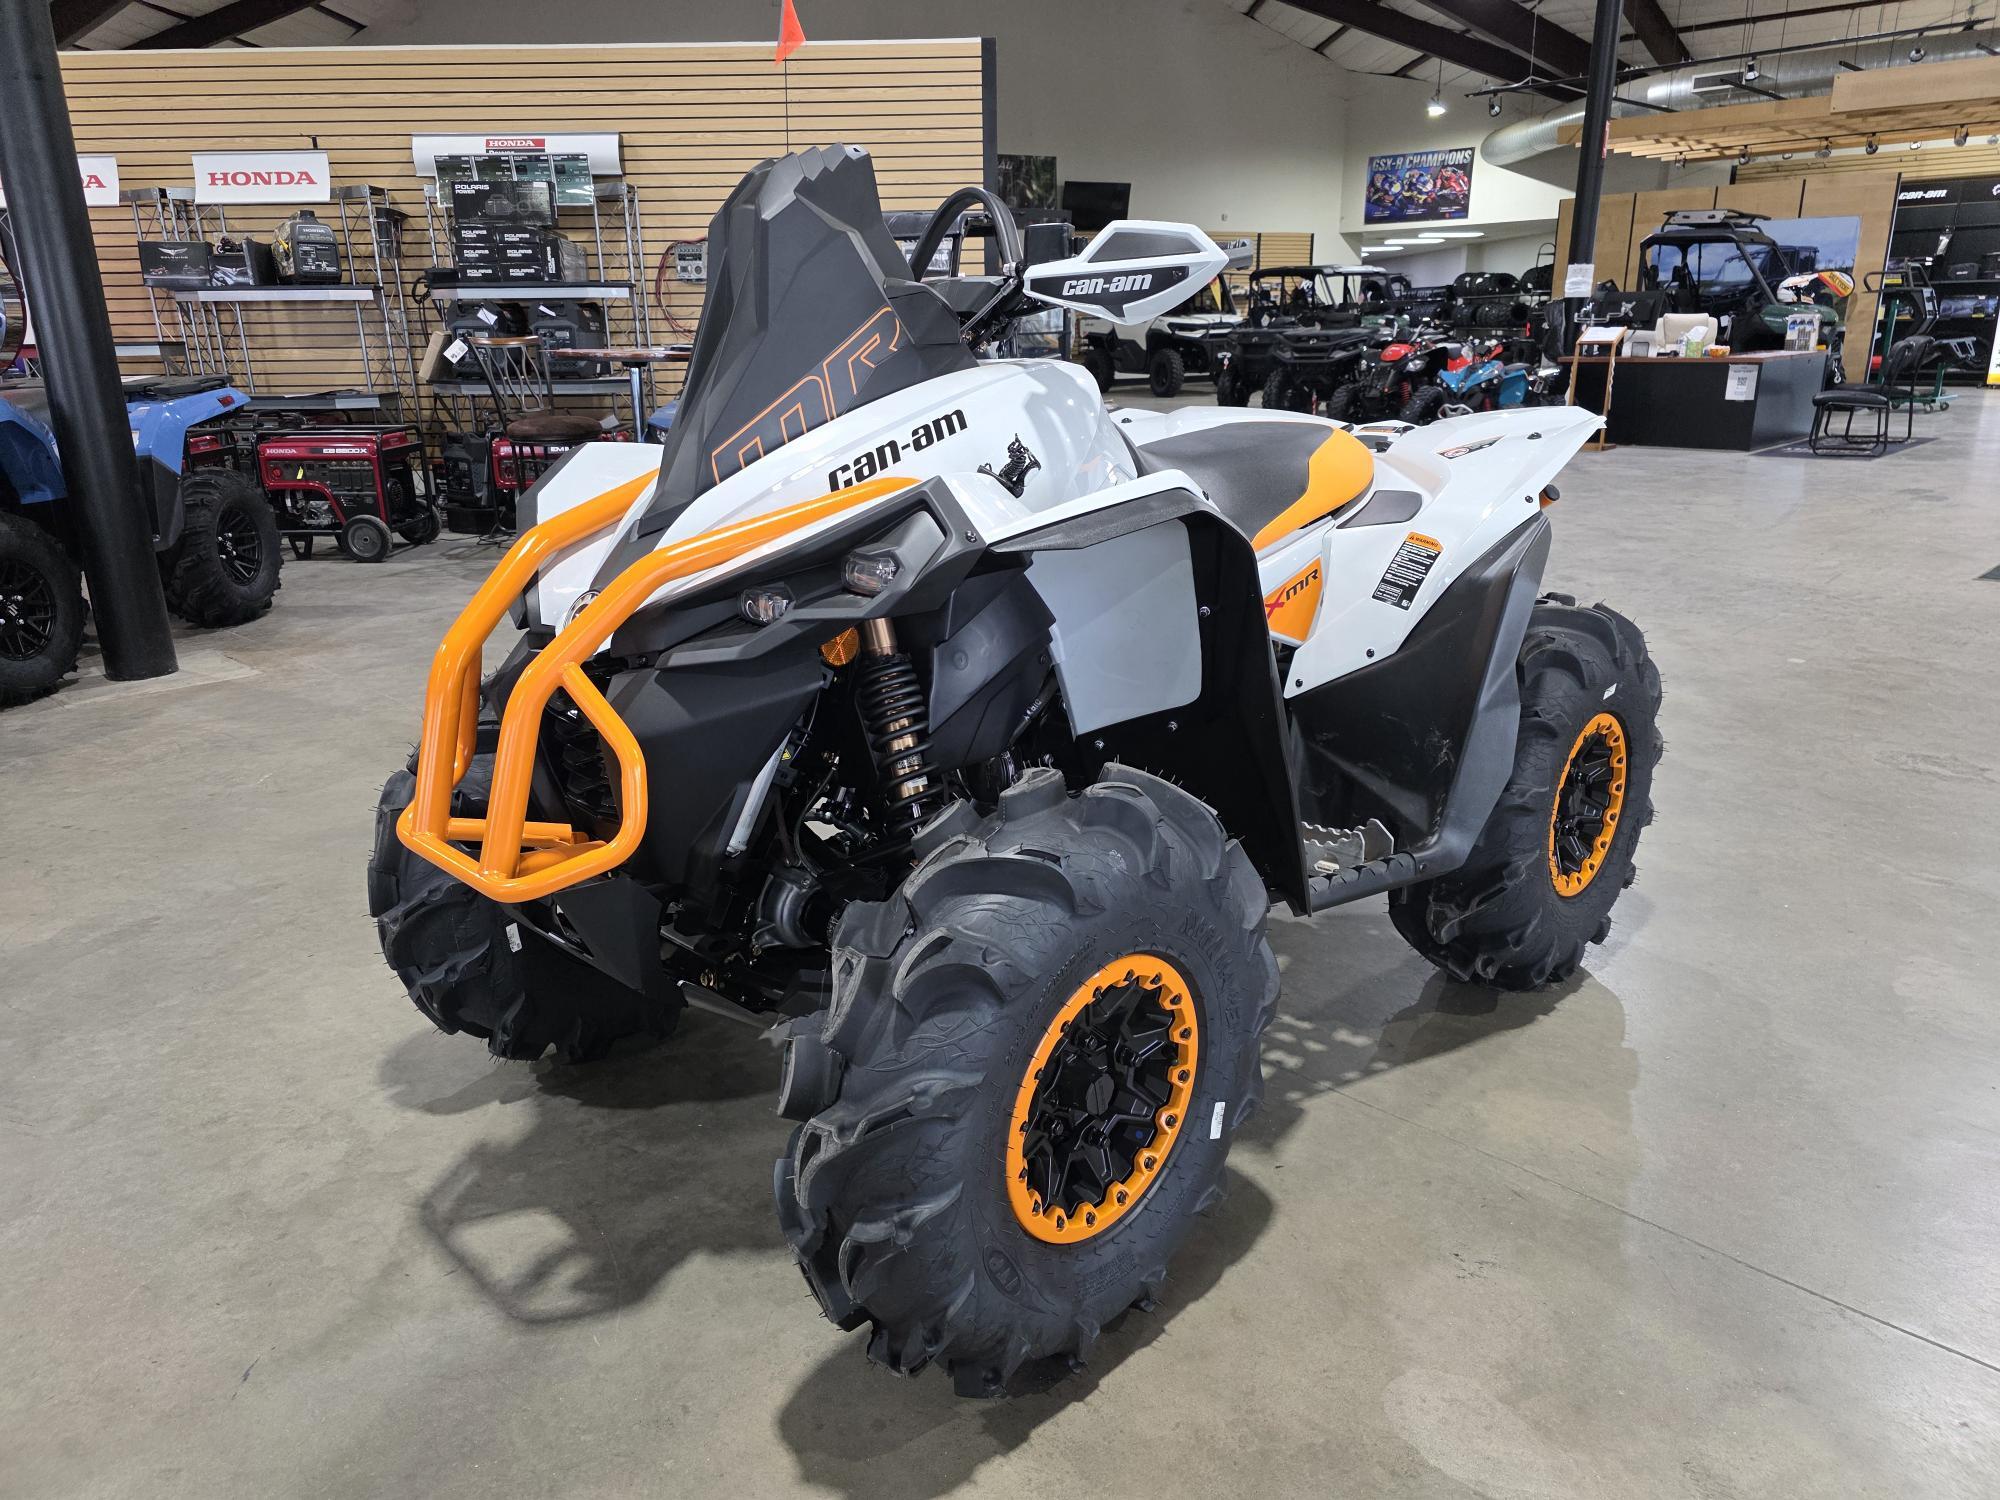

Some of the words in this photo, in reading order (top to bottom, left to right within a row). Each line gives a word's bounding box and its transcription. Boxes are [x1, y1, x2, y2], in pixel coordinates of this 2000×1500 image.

[1373, 158, 1404, 172] GSX-R
[1405, 149, 1472, 168] CHAMPIONS
[208, 171, 317, 186] HONDA
[1898, 189, 1948, 200] can-am
[1062, 273, 1153, 296] can-am
[828, 409, 968, 493] can-am
